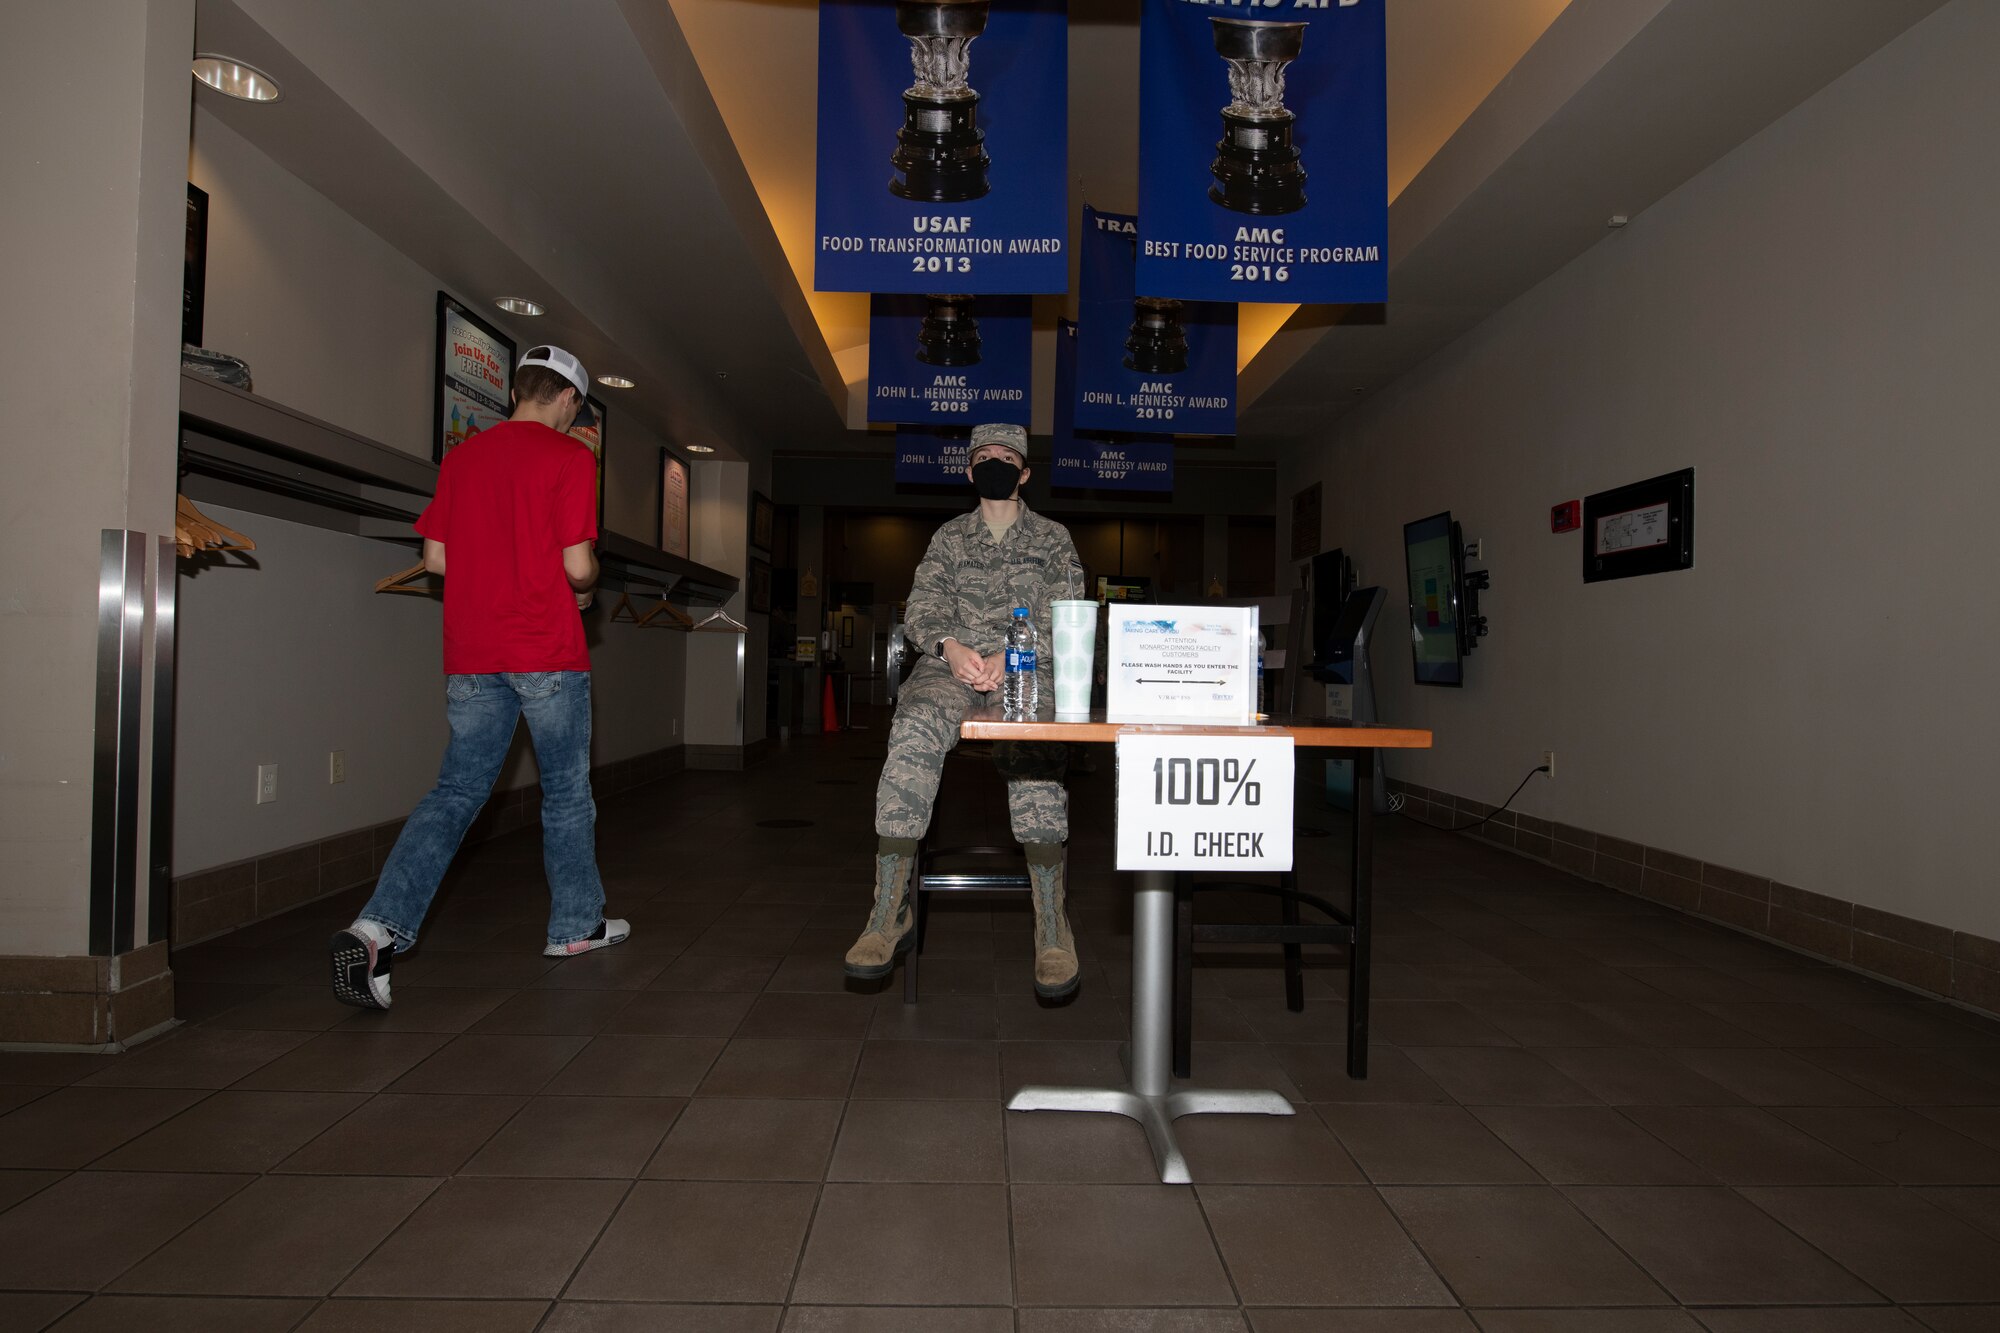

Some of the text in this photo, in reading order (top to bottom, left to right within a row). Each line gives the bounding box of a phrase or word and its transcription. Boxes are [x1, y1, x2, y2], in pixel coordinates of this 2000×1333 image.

[913, 216, 972, 233] USAF
[1234, 226, 1284, 245] AMC
[822, 236, 1061, 254] FOOD TRANSFORMATION AWARD
[1145, 240, 1379, 263] BEST FOOD SERVICE PROGRAM
[912, 256, 971, 272] 2013
[1230, 264, 1289, 282] 2016
[454, 342, 473, 357] Join
[473, 347, 485, 363] Us
[487, 354, 500, 373] for
[461, 356, 482, 379] FREE
[483, 367, 504, 390] Fun!
[454, 381, 468, 395] April
[933, 375, 967, 387] AMC
[1139, 382, 1172, 394] AMC
[876, 386, 1023, 401] JOHN L. HENNESSY AWARD
[1083, 392, 1228, 408] JOHN L. HENNESSY AWARD
[930, 401, 969, 412] 2008
[1136, 408, 1174, 420] 2010
[901, 454, 925, 464] JOHN
[928, 455, 935, 464] L.
[1100, 451, 1126, 460] AMC
[942, 465, 966, 474] 200
[1057, 458, 1167, 472] JOHN L. HENNESSY AWARD
[1097, 471, 1127, 480] 2007
[1153, 757, 1261, 806] 100%
[1147, 831, 1264, 858] I.D. CHECK
